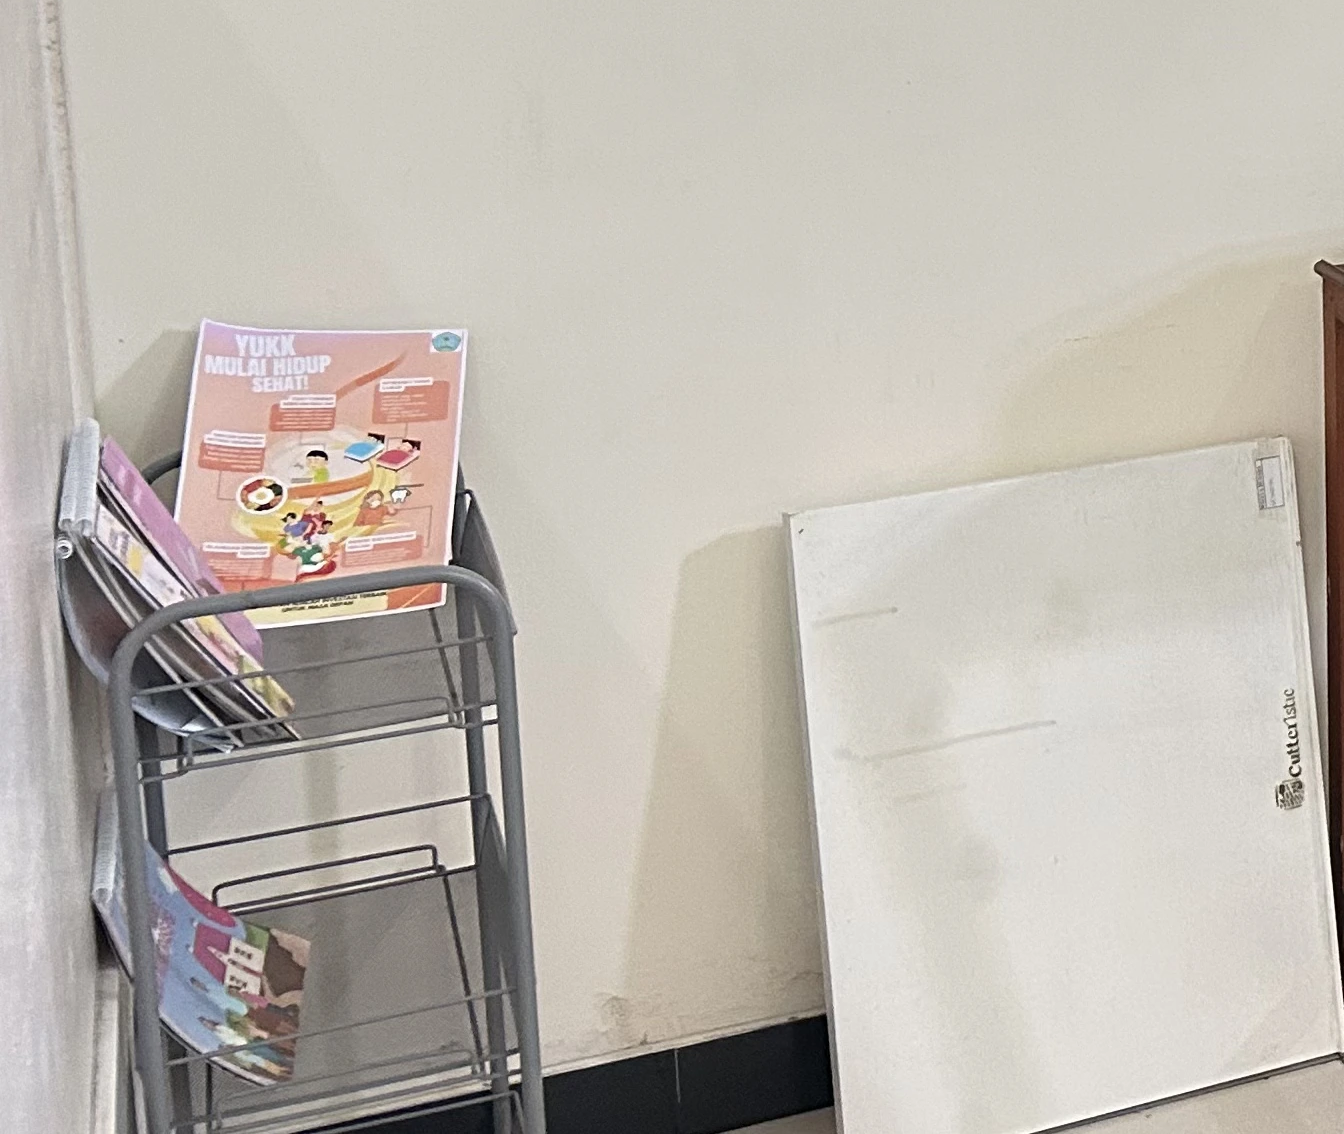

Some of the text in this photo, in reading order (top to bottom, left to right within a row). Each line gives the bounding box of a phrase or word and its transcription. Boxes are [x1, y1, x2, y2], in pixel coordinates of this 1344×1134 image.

[235, 334, 296, 356] YUKK
[204, 355, 331, 375] MULAI HIDUP
[251, 375, 309, 393] SEHAT!
[1281, 688, 1303, 777] Cutteristic
